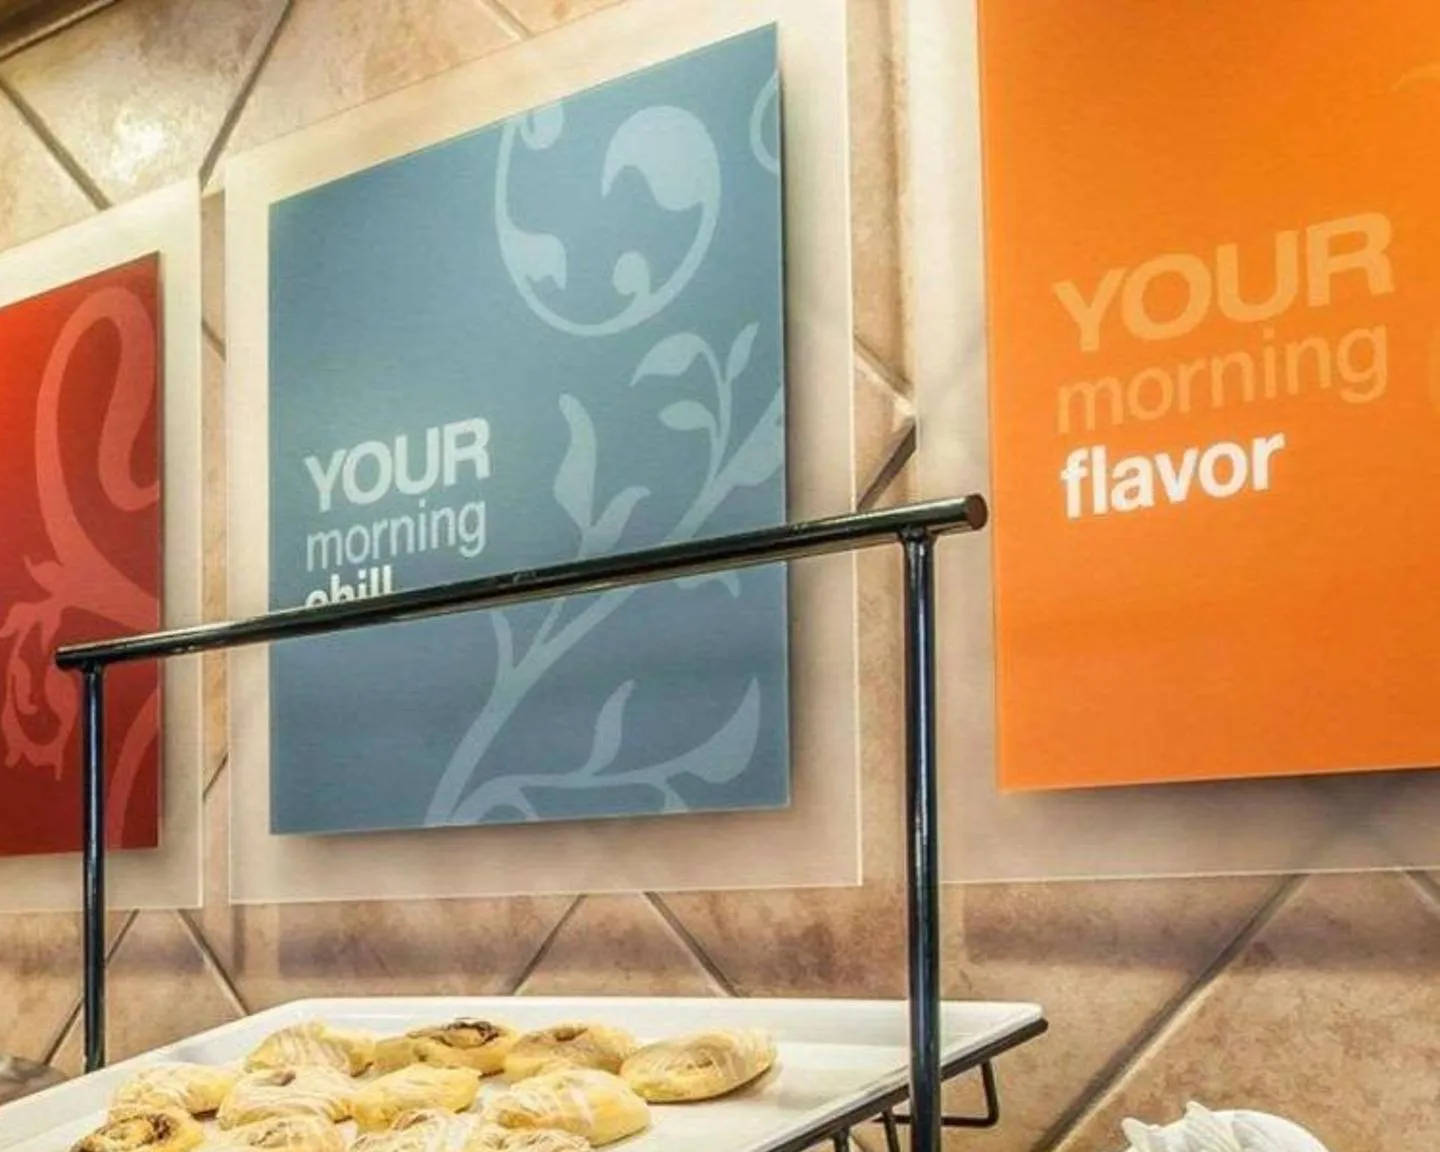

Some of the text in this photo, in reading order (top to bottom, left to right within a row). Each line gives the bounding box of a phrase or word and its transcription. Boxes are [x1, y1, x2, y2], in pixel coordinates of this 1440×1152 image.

[1052, 212, 1394, 352] YOUR
[1057, 324, 1387, 434] morning
[304, 417, 490, 512] YOUR
[1060, 432, 1286, 519] flavor
[307, 498, 486, 572] morning
